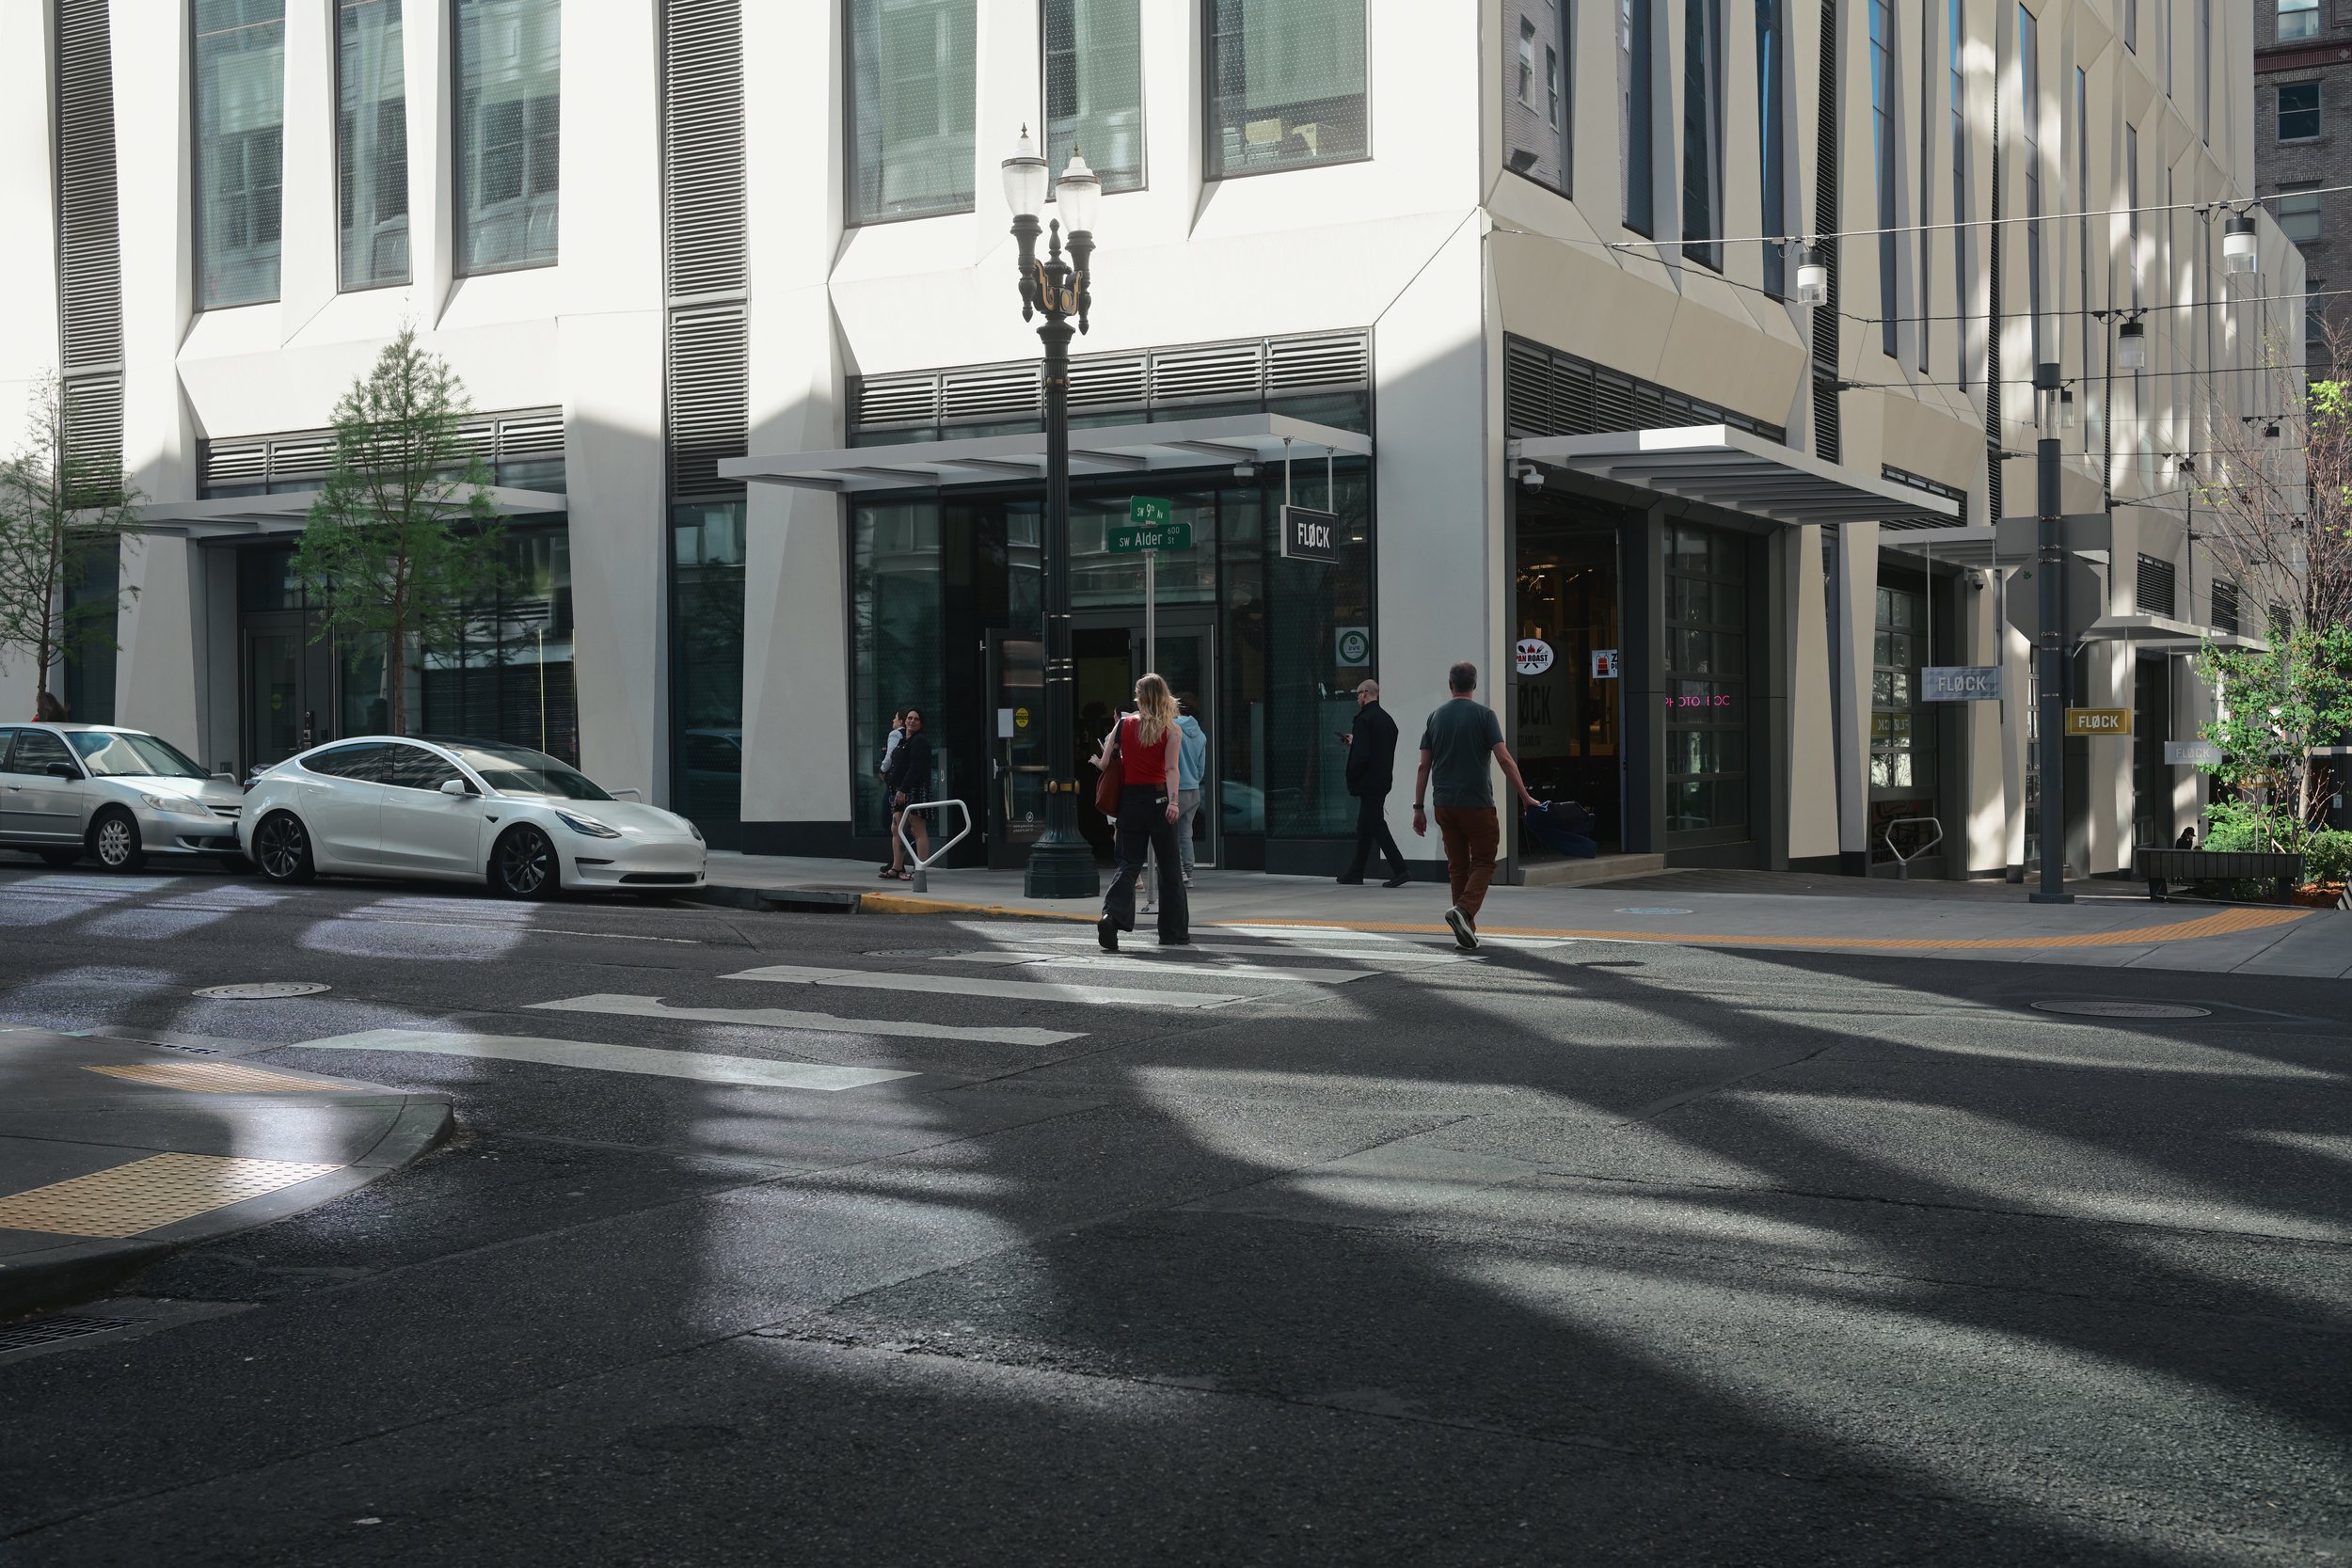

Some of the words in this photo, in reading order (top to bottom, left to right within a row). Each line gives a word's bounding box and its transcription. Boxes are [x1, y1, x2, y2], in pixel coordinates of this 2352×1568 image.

[1136, 507, 1144, 517] SW
[1146, 503, 1155, 517] 9th
[1156, 509, 1164, 519] Av
[1167, 526, 1180, 534] 600
[1297, 522, 1330, 548] FLØCK
[1119, 537, 1130, 547] SW
[1135, 531, 1163, 546] Alder
[1168, 536, 1175, 545] St
[1528, 654, 1549, 662] ROAST
[1938, 675, 1986, 692] FLØCK
[2078, 715, 2119, 729] FLØCK
[2175, 748, 2210, 759] FLØCK
